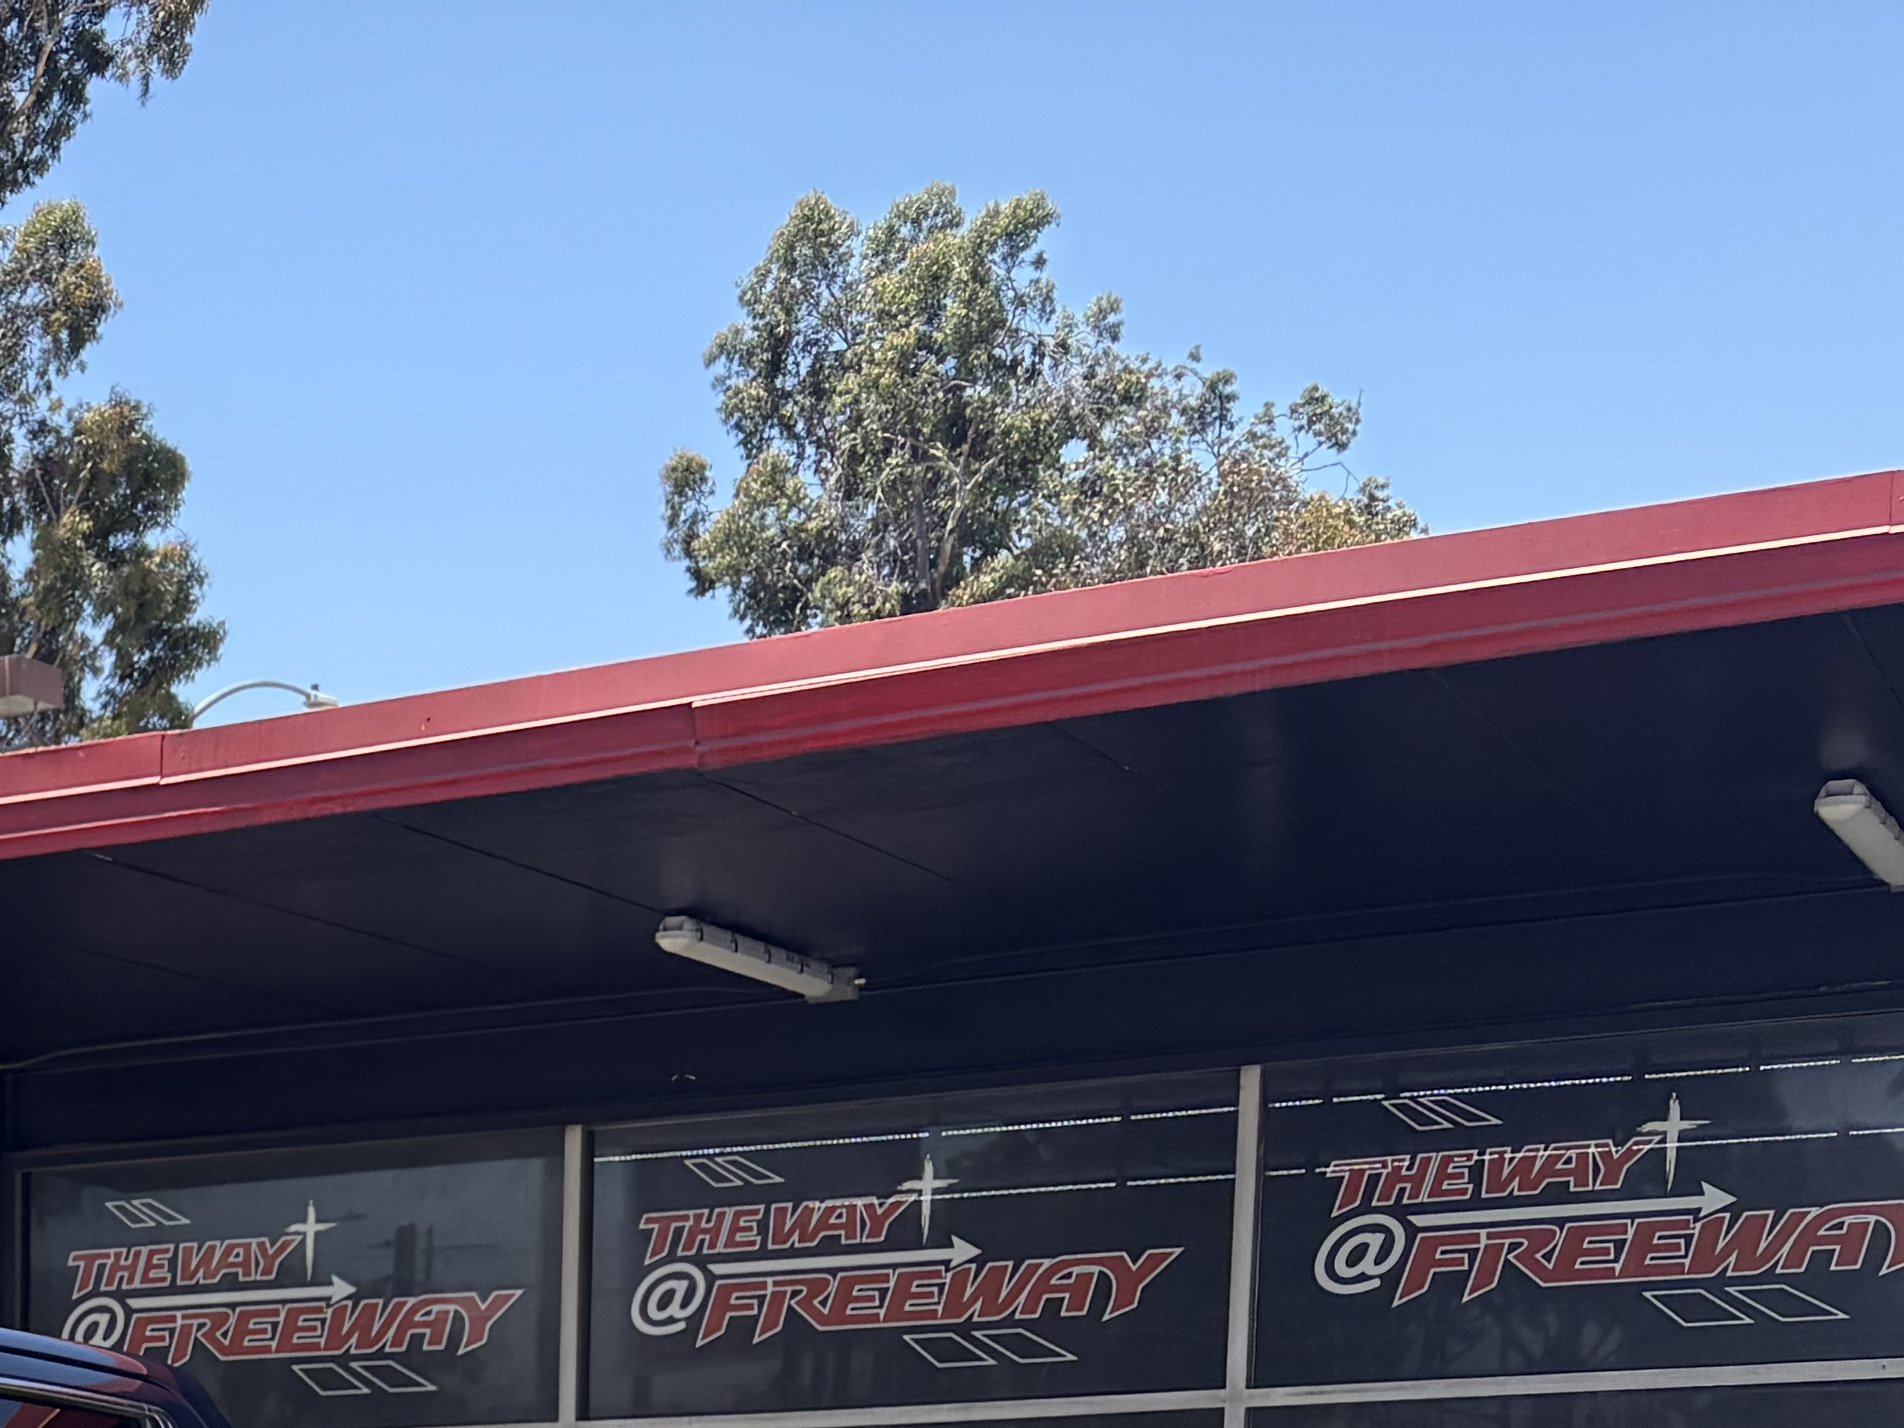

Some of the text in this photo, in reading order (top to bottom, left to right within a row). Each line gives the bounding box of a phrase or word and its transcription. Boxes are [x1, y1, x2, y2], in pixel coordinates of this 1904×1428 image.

[631, 1247, 1185, 1348] @FREEWAY
[1314, 1199, 1904, 1308] @FREEWA
[61, 1288, 527, 1368] @FREEWAY
